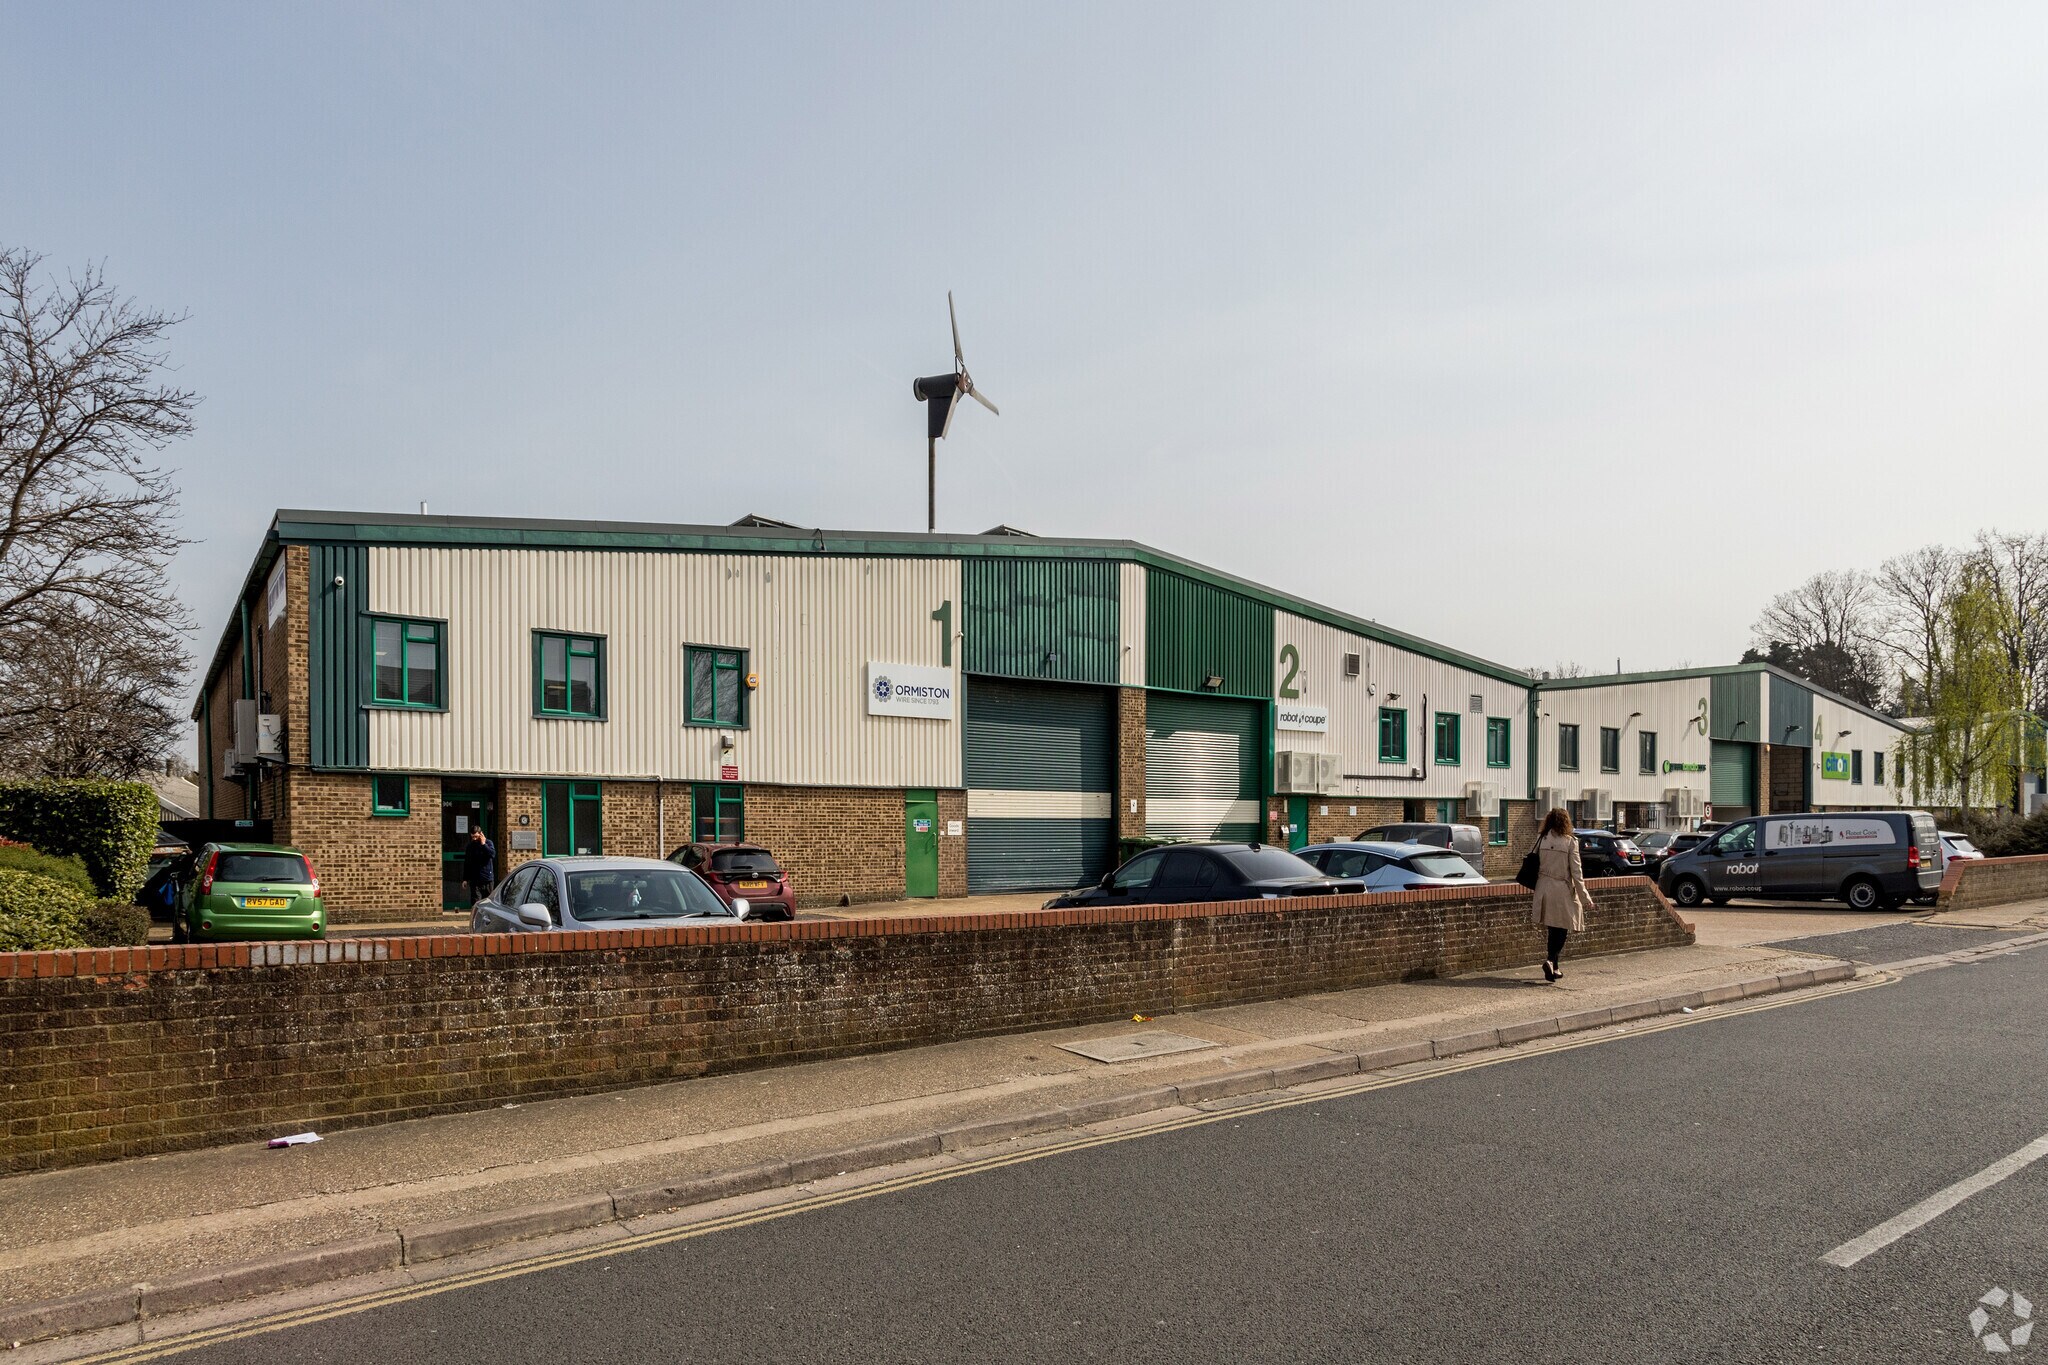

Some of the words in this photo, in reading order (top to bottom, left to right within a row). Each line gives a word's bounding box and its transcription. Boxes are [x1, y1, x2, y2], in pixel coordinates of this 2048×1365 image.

[932, 600, 951, 667] 1
[1279, 644, 1299, 699] 2
[895, 684, 950, 699] ORMISTON
[895, 696, 911, 704] WIRE
[911, 697, 928, 705] SINCE
[928, 698, 940, 706] 1793
[1280, 711, 1299, 723] robot
[1304, 715, 1326, 727] coupe
[1697, 697, 1708, 736] 3
[1814, 714, 1823, 747] 4
[1706, 805, 1712, 816] 5
[1726, 862, 1760, 875] robot
[246, 897, 268, 906] RV57
